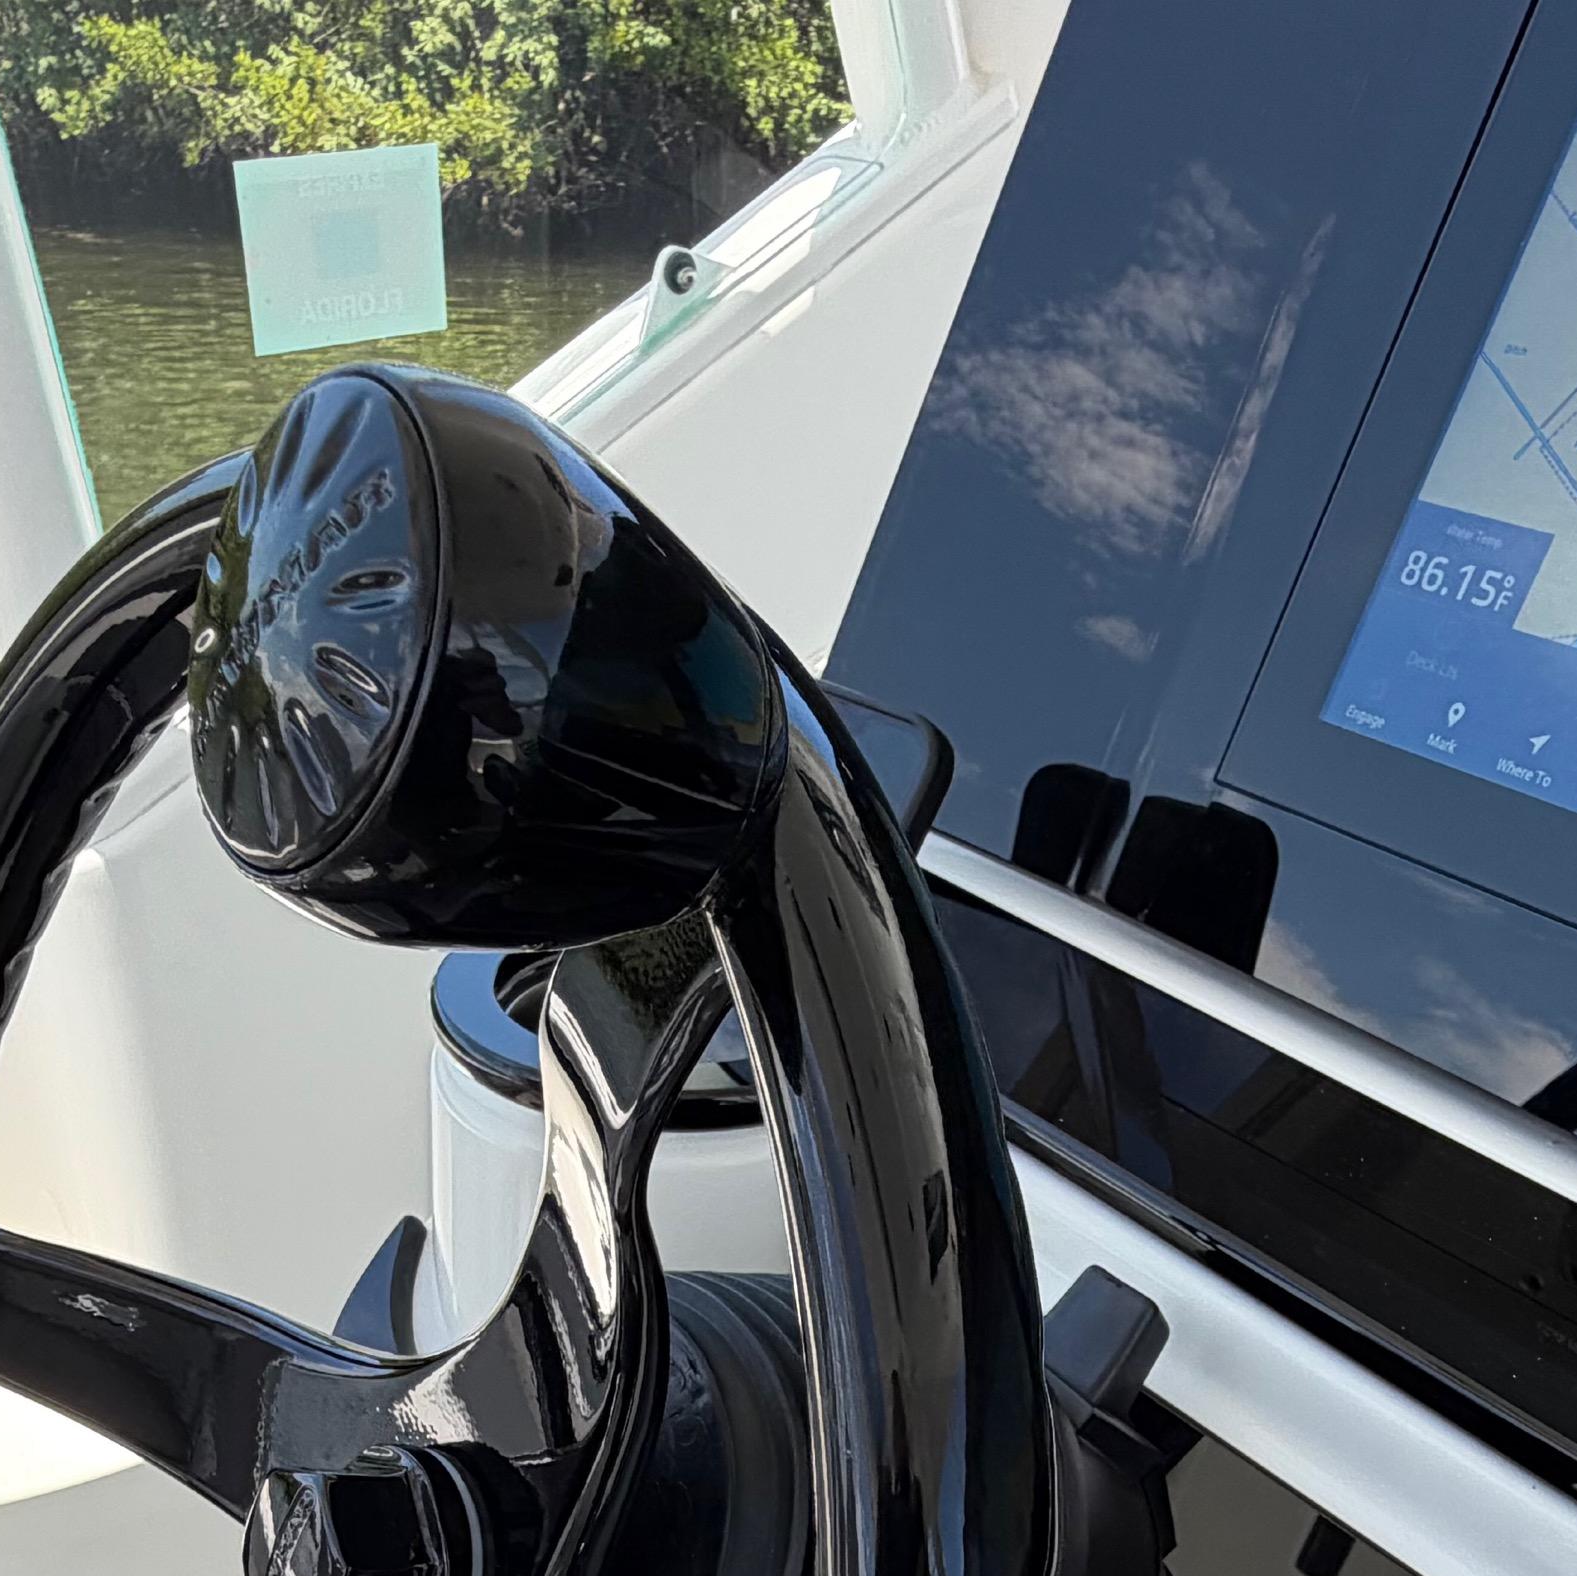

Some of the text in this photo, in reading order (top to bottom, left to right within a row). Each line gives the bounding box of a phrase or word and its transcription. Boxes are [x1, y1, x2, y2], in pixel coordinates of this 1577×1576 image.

[1345, 704, 1385, 730] Engage
[1427, 732, 1457, 754] Mark
[1497, 757, 1552, 787] Where To
